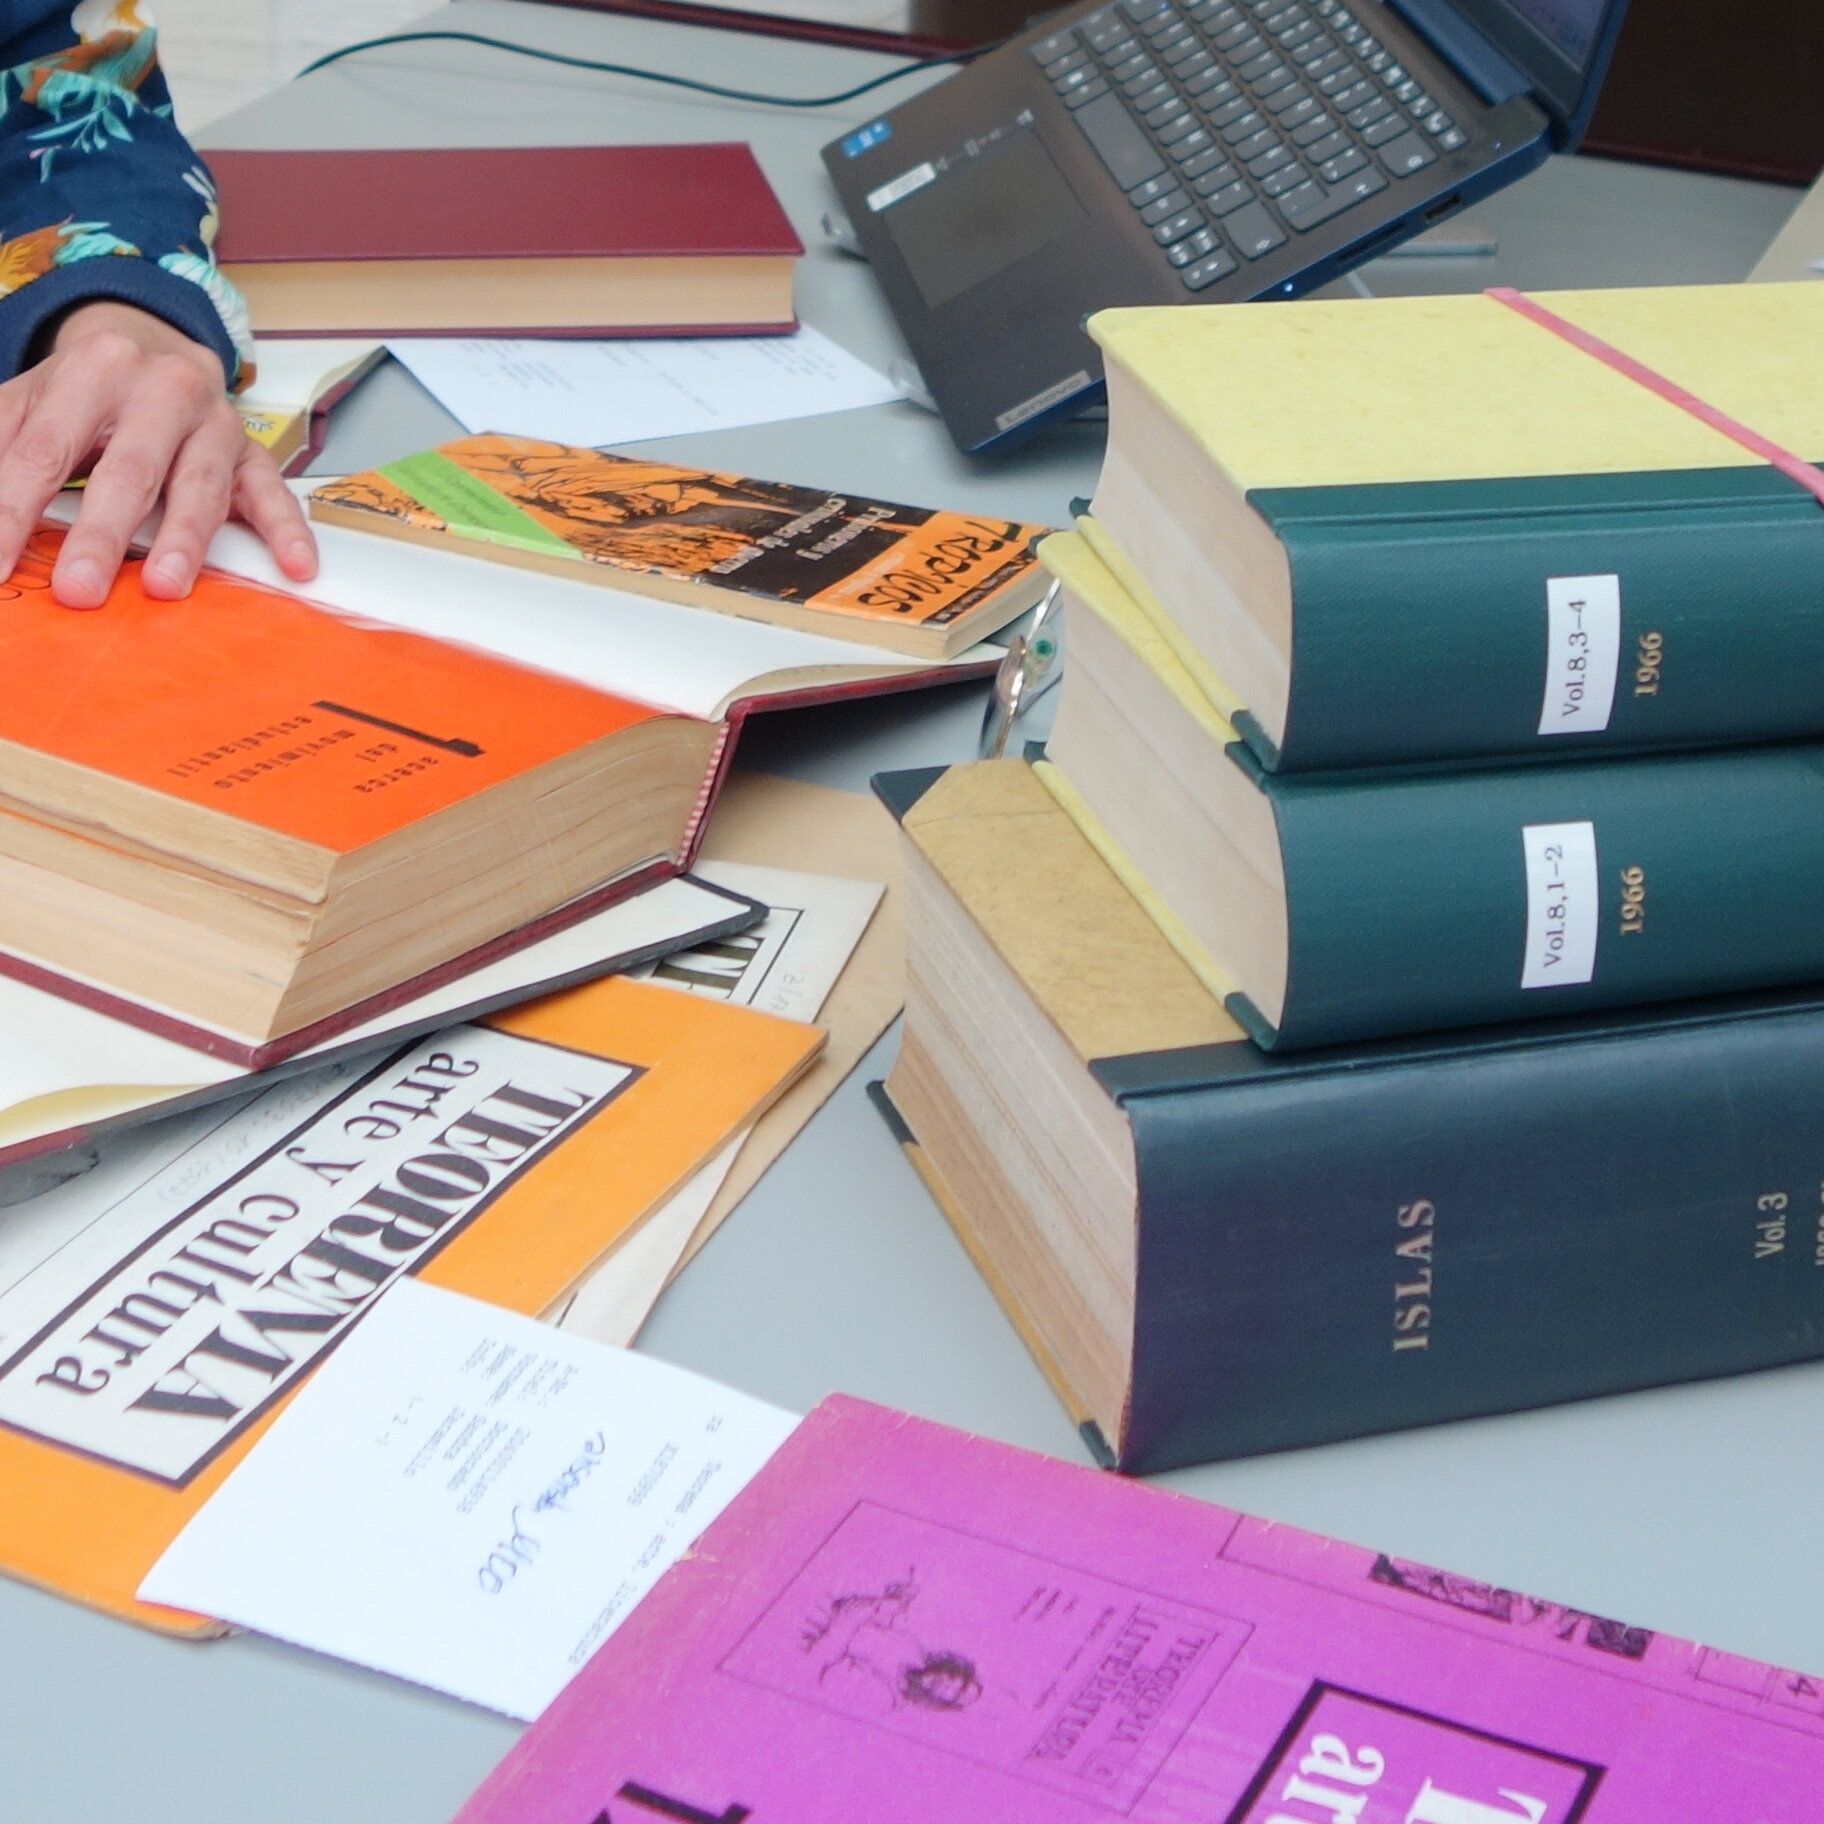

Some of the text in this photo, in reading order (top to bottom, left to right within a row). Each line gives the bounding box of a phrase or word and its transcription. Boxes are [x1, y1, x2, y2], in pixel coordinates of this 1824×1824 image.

[1634, 630, 1663, 697] 1966
[163, 714, 313, 778] estudiantil
[210, 728, 357, 790] movimiento
[351, 755, 439, 795] acerca
[353, 742, 401, 765] del
[1619, 863, 1645, 936] 1966
[334, 1049, 494, 1151] arte
[270, 1145, 367, 1186] y
[121, 1078, 593, 1435] TEOREMA
[1755, 1191, 1789, 1259] Vol. 3
[33, 1192, 306, 1399] cultura
[1392, 1196, 1436, 1354] ISLAS
[456, 1337, 499, 1375] Info:
[477, 1343, 519, 1382] Name:
[438, 1352, 539, 1461] Vorname: Sandra
[443, 1420, 510, 1493] Doctorado
